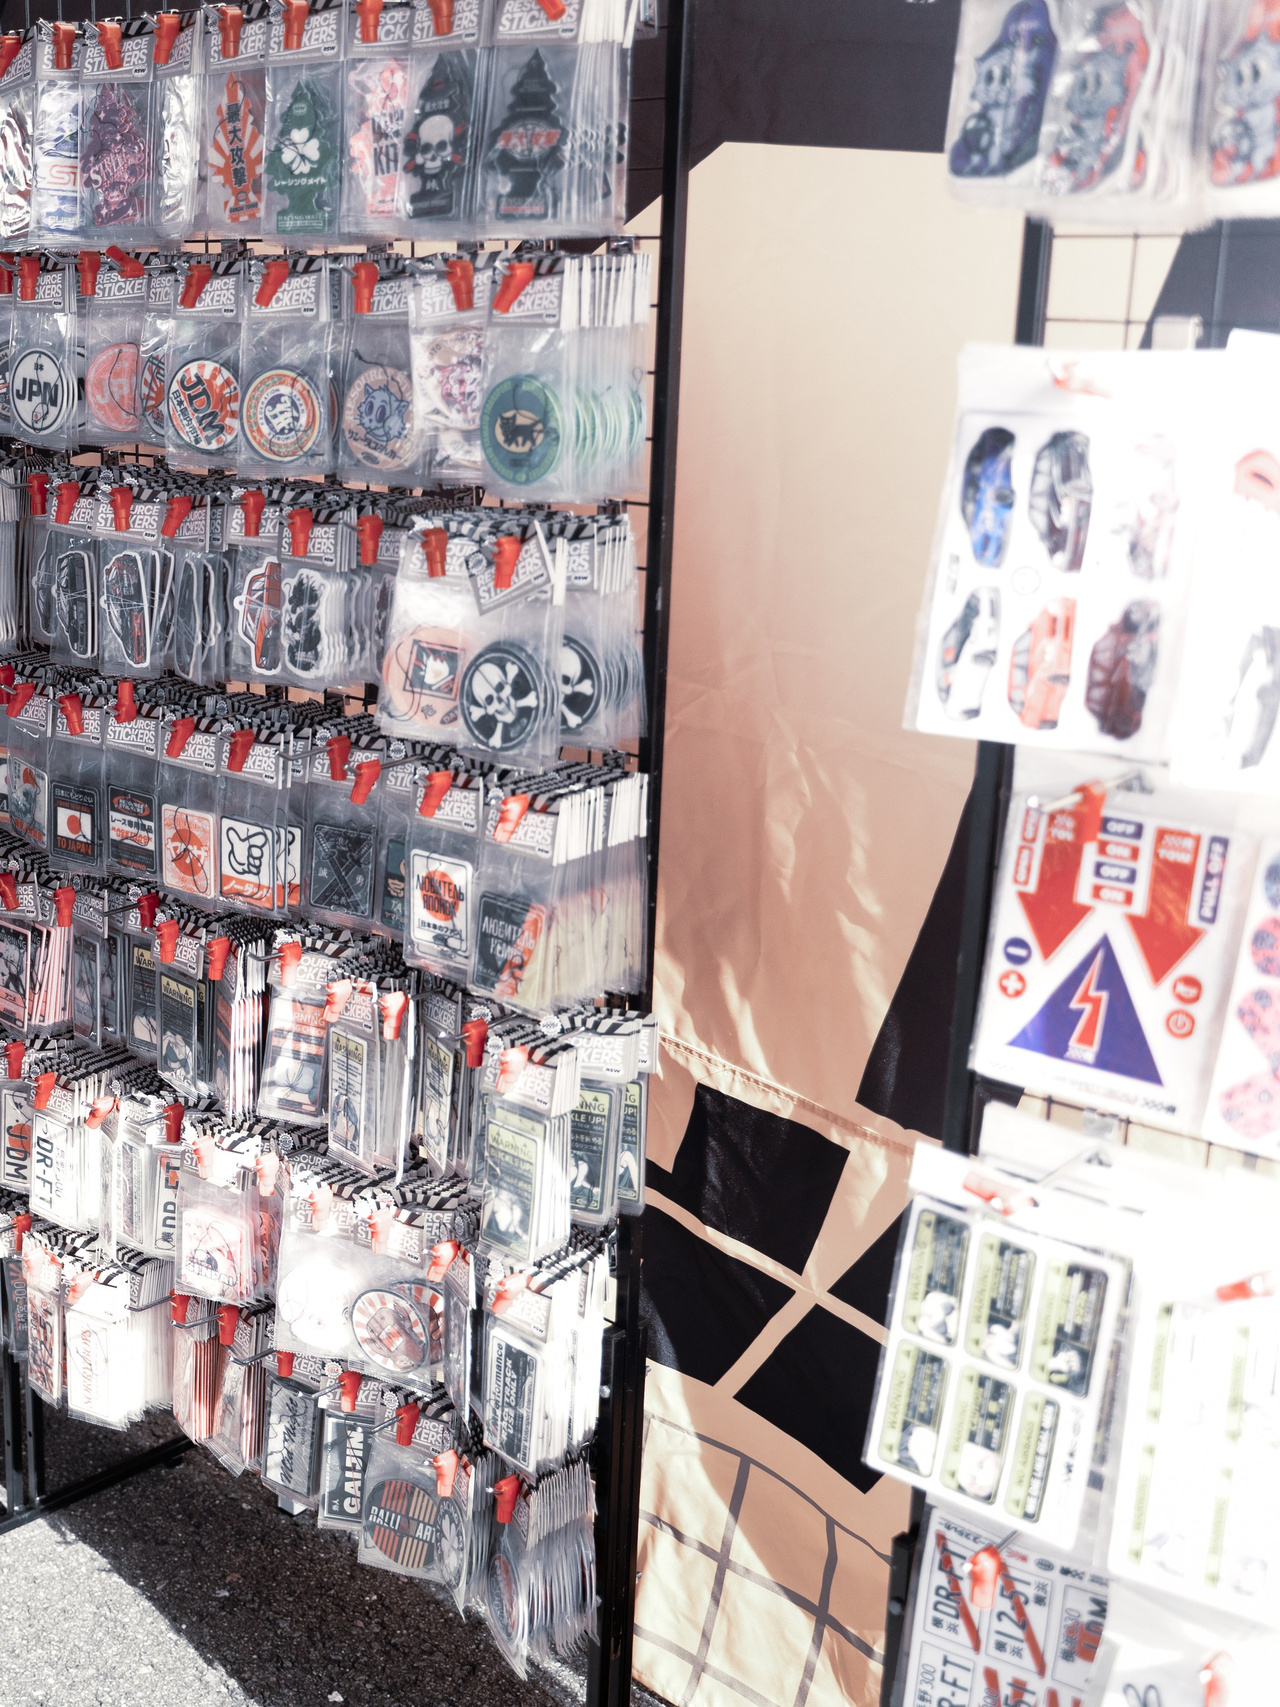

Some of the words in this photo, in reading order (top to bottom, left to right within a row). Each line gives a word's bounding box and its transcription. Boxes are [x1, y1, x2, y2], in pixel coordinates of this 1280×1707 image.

[414, 1, 477, 23] RESRCE
[271, 11, 336, 39] REURCE
[413, 14, 477, 43] STIERS
[86, 38, 148, 59] RESURCE
[270, 26, 336, 56] STKERS
[84, 50, 147, 77] STIKERS
[133, 67, 147, 76] RSW
[15, 376, 60, 408] JPN
[179, 372, 227, 446] JDM
[97, 513, 159, 530] STKERS
[99, 502, 161, 517] REURCE
[144, 532, 157, 540] RSW
[107, 727, 156, 744] STICKERS
[57, 836, 68, 848] TO
[68, 839, 92, 856] JAPAN
[136, 956, 156, 969] WARN
[163, 984, 193, 1005] WARNING
[5, 1125, 28, 1181] JDM
[490, 1131, 533, 1161] WARNING
[14, 1281, 27, 1305] 300
[887, 1370, 908, 1431] WARNING
[369, 1505, 401, 1530] RALLI
[932, 1542, 967, 1620] DR-FT
[995, 1571, 1032, 1644] 12-51
